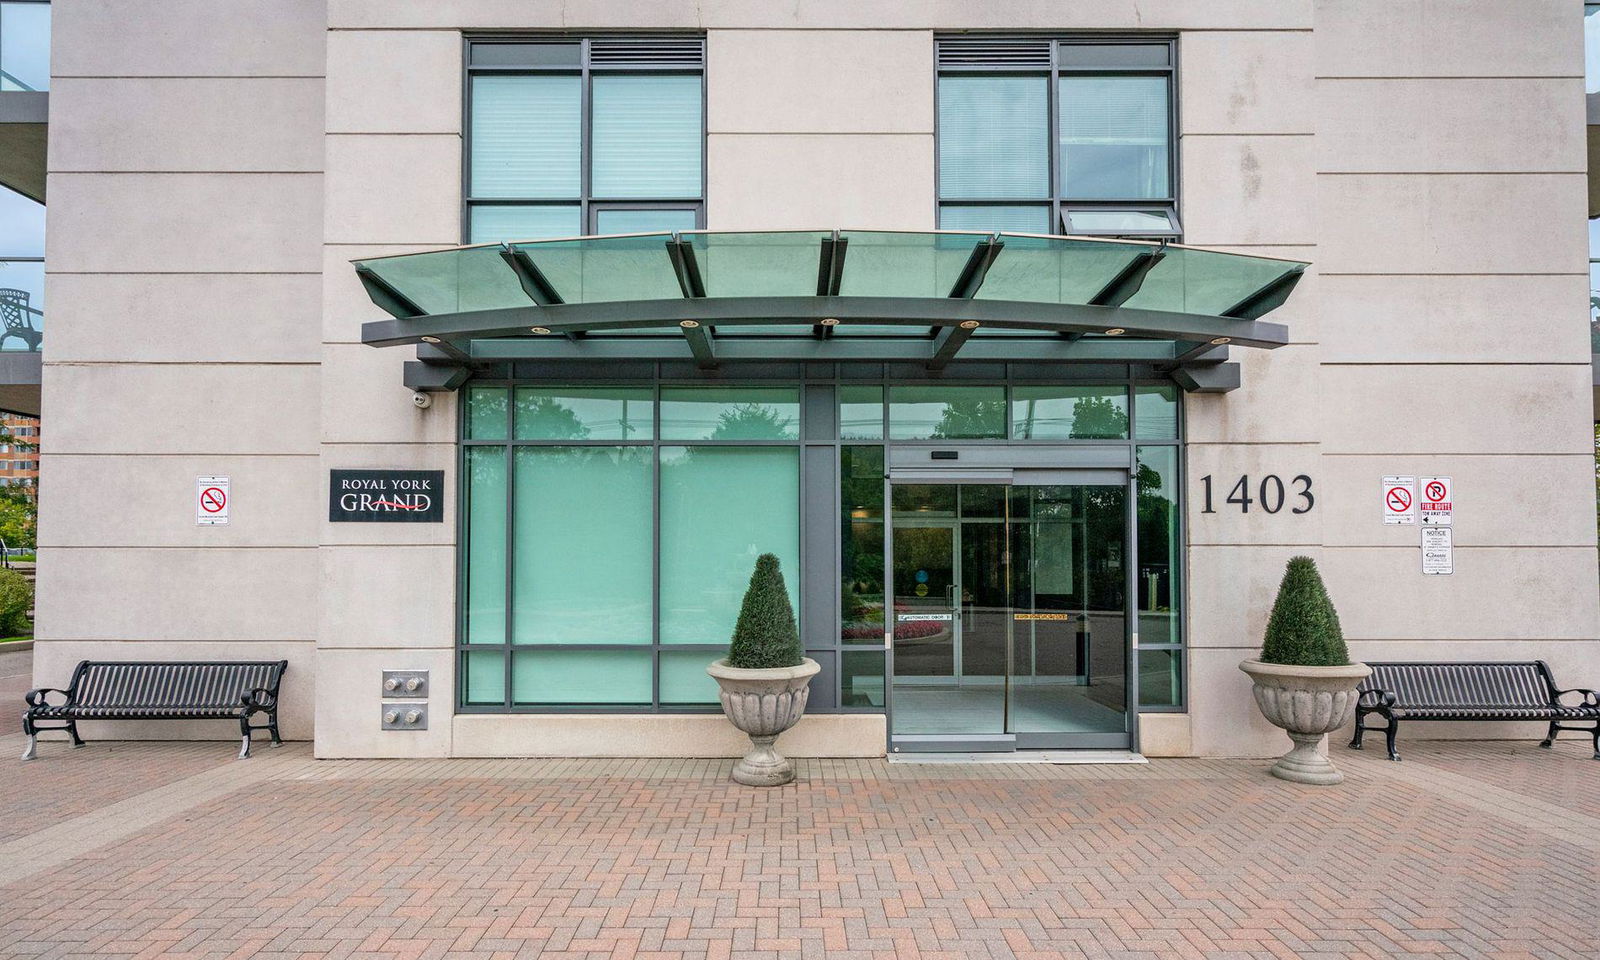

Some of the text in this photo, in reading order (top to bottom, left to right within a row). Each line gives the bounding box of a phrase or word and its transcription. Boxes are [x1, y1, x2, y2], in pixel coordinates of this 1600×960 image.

[342, 480, 431, 490] ROYAL YORK
[1200, 474, 1314, 514] 1403
[340, 493, 431, 512] GRAND
[1422, 502, 1451, 510] FIRE ROUTE
